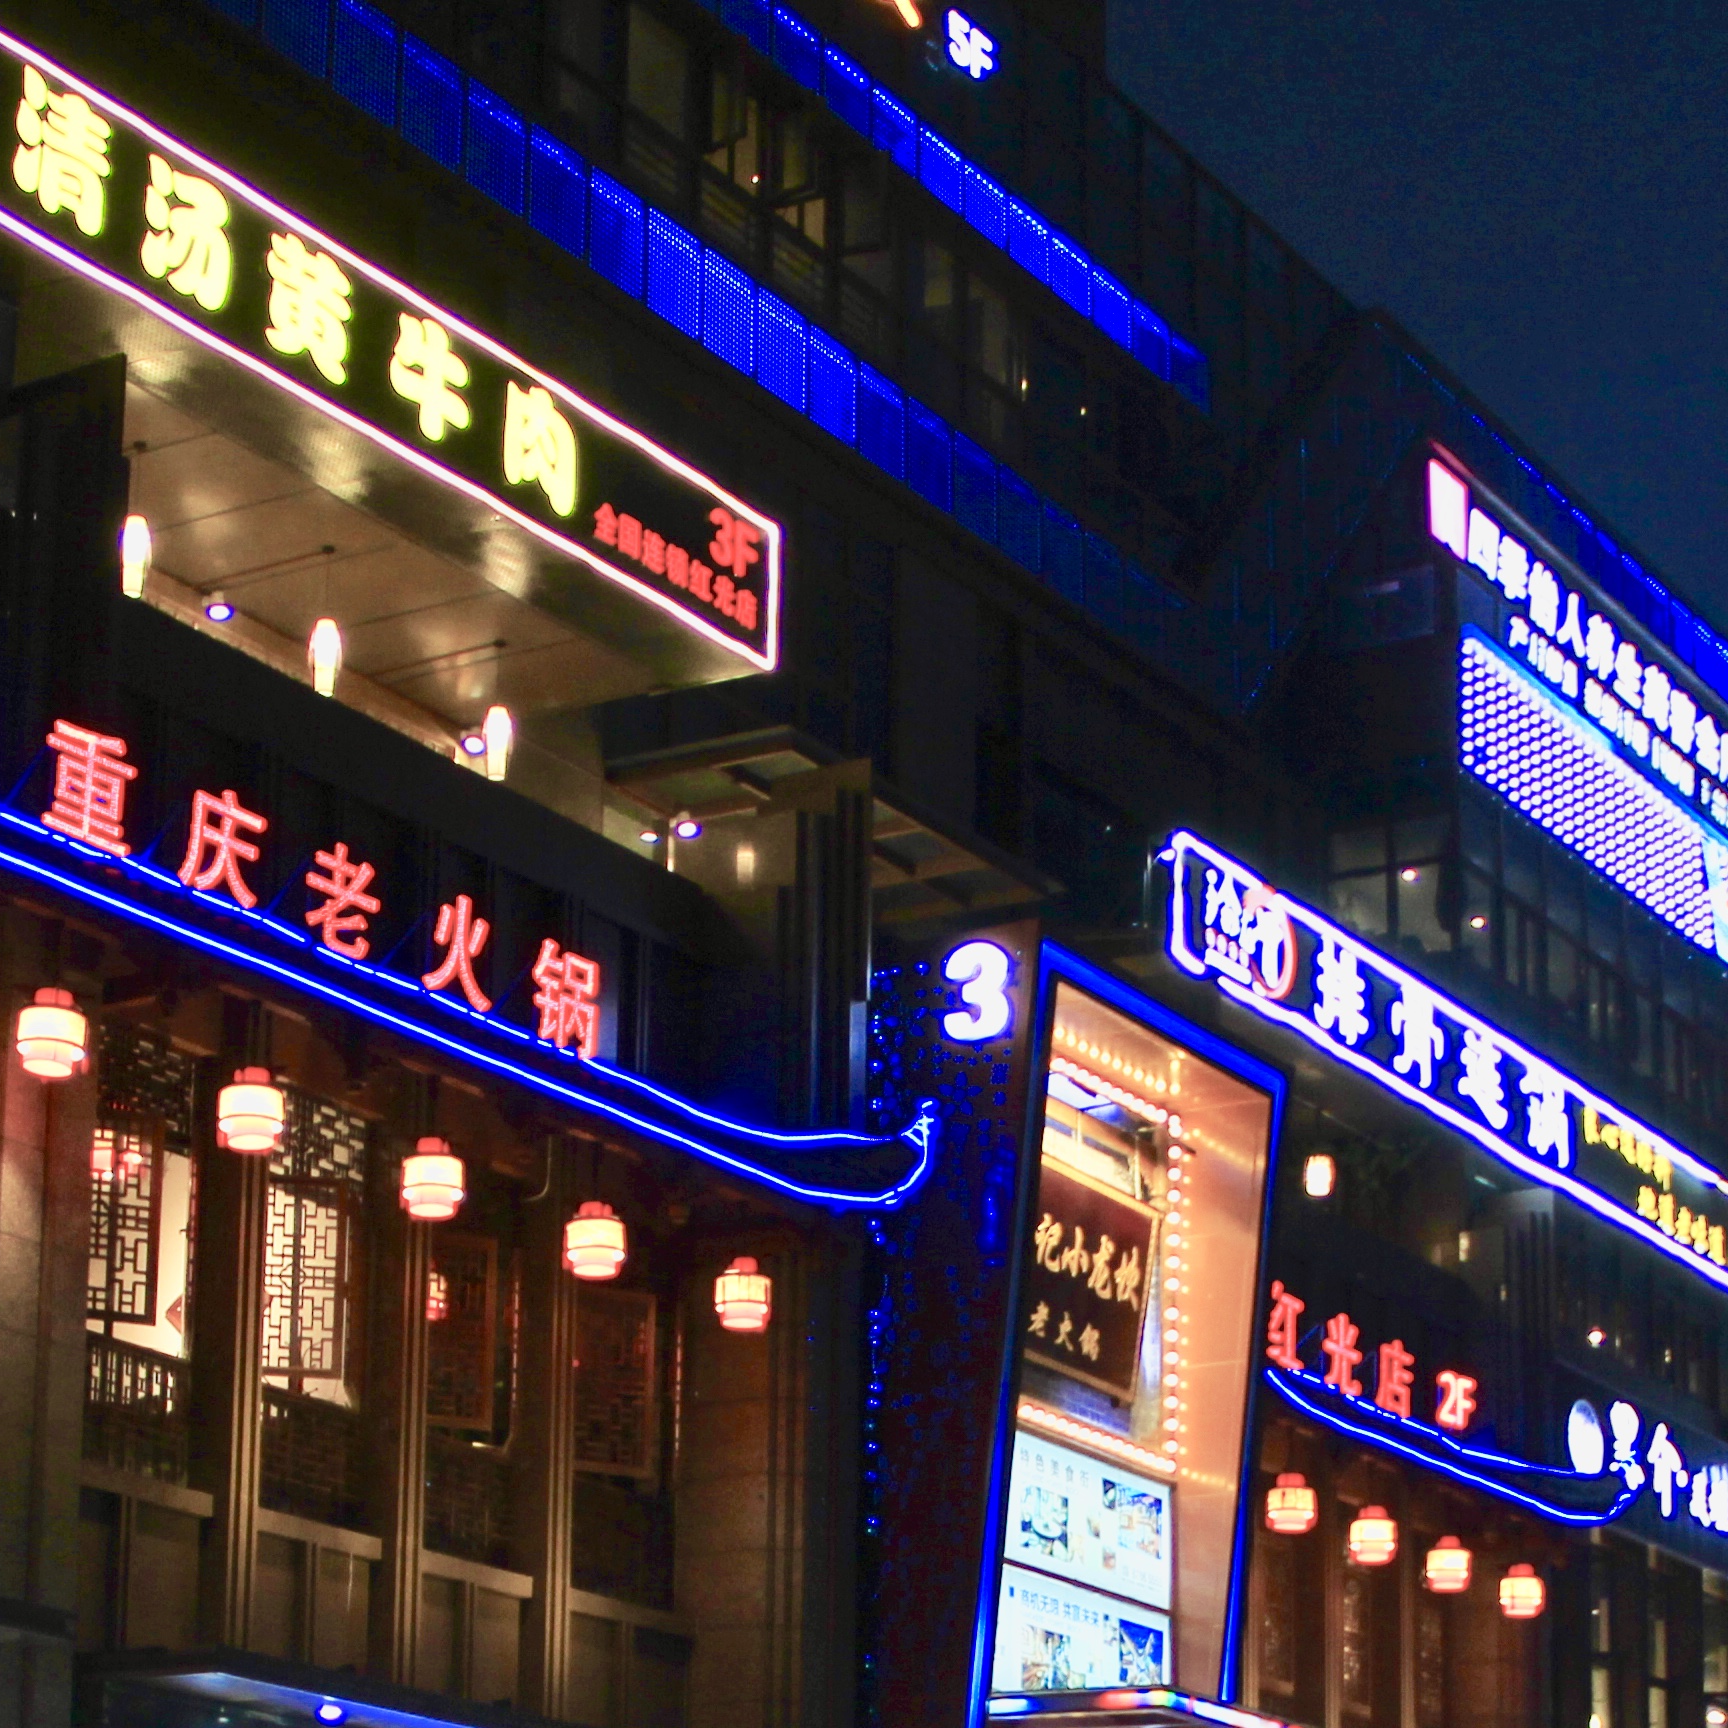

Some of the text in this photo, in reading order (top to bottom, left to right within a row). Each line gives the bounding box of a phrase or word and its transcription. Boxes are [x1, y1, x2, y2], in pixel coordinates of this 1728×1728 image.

[948, 9, 995, 80] 5F
[12, 62, 579, 519] 清汤黄牛肉
[709, 507, 760, 578] 3F
[41, 719, 603, 1060] 重庆老火锅
[943, 941, 1011, 1044] 3
[1266, 1280, 1478, 1431] 红光店 2F
